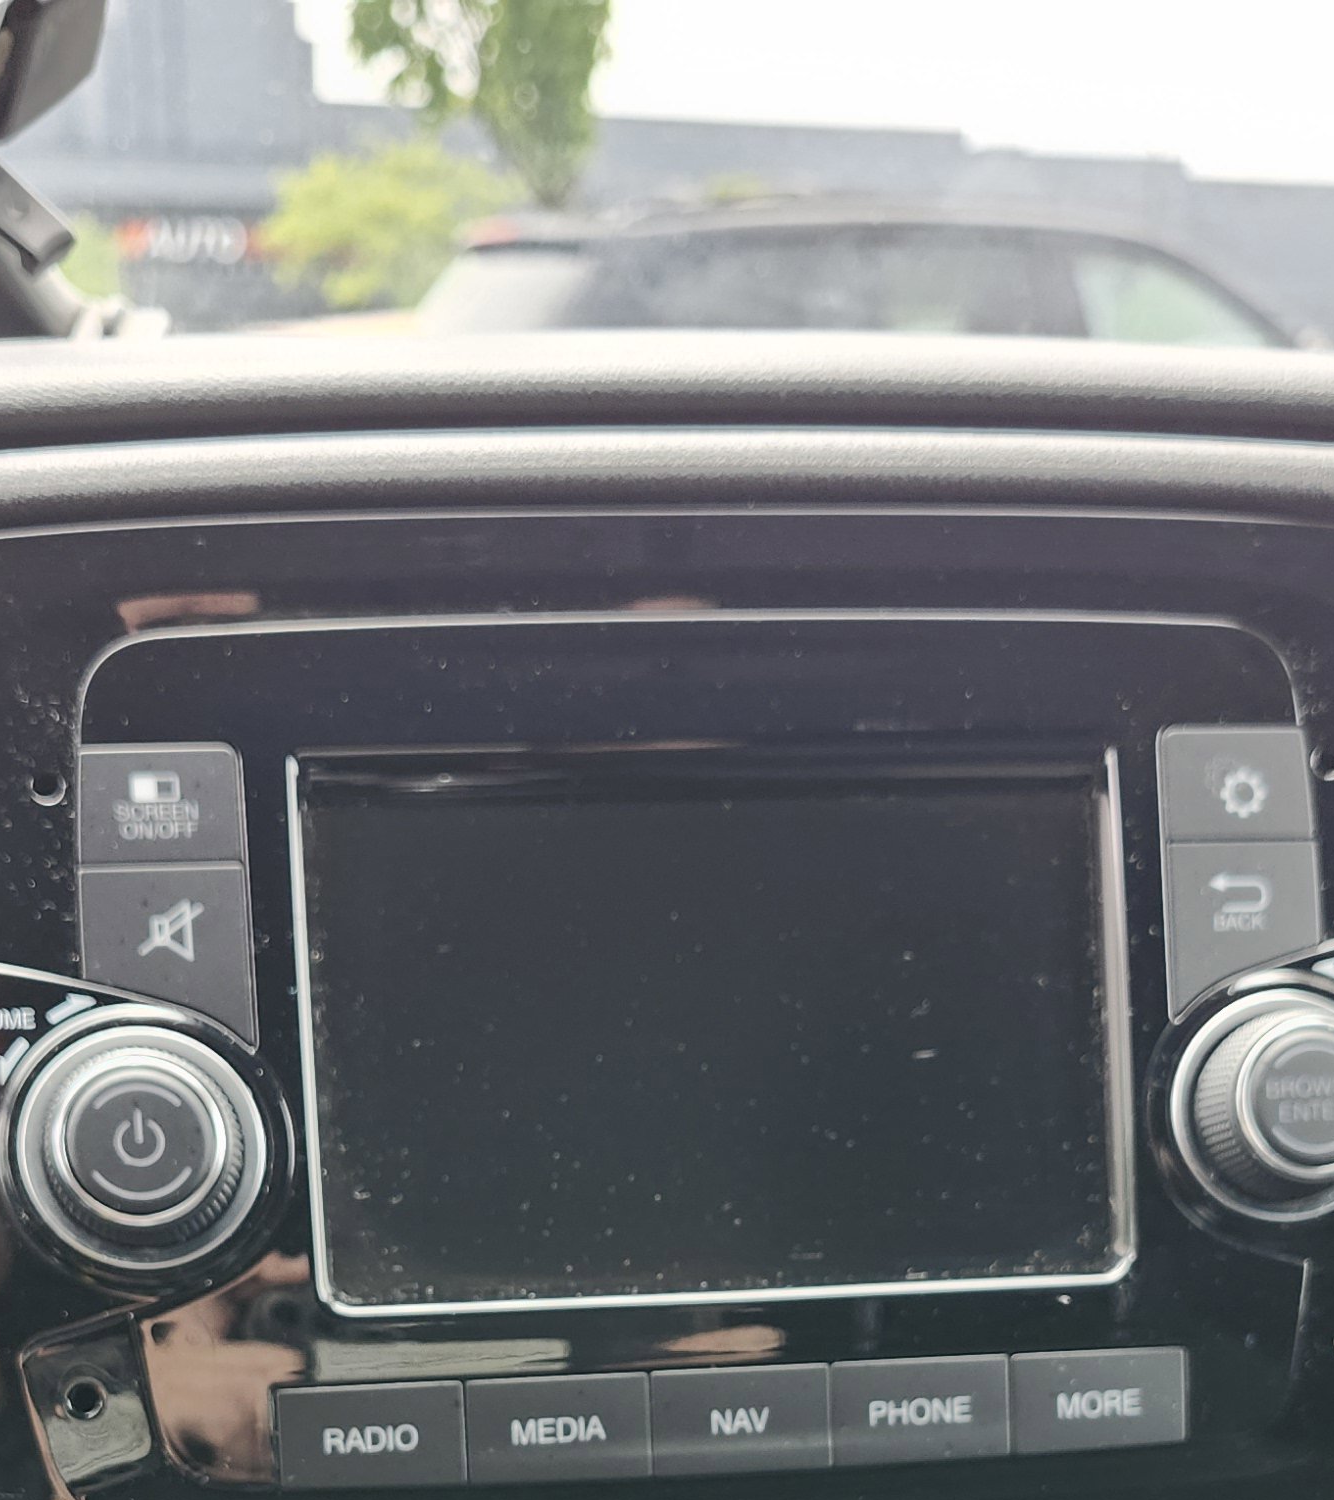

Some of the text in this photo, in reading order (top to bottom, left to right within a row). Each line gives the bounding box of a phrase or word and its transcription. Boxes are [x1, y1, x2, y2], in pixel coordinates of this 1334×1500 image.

[113, 802, 200, 823] SCREEN
[118, 822, 199, 841] ON/OFF
[1213, 912, 1264, 932] BACK
[868, 1395, 972, 1427] PHONE
[1056, 1388, 1143, 1421] MORE
[510, 1414, 606, 1446] MEDIA
[709, 1406, 769, 1436] NAV
[322, 1422, 419, 1456] RADIO
